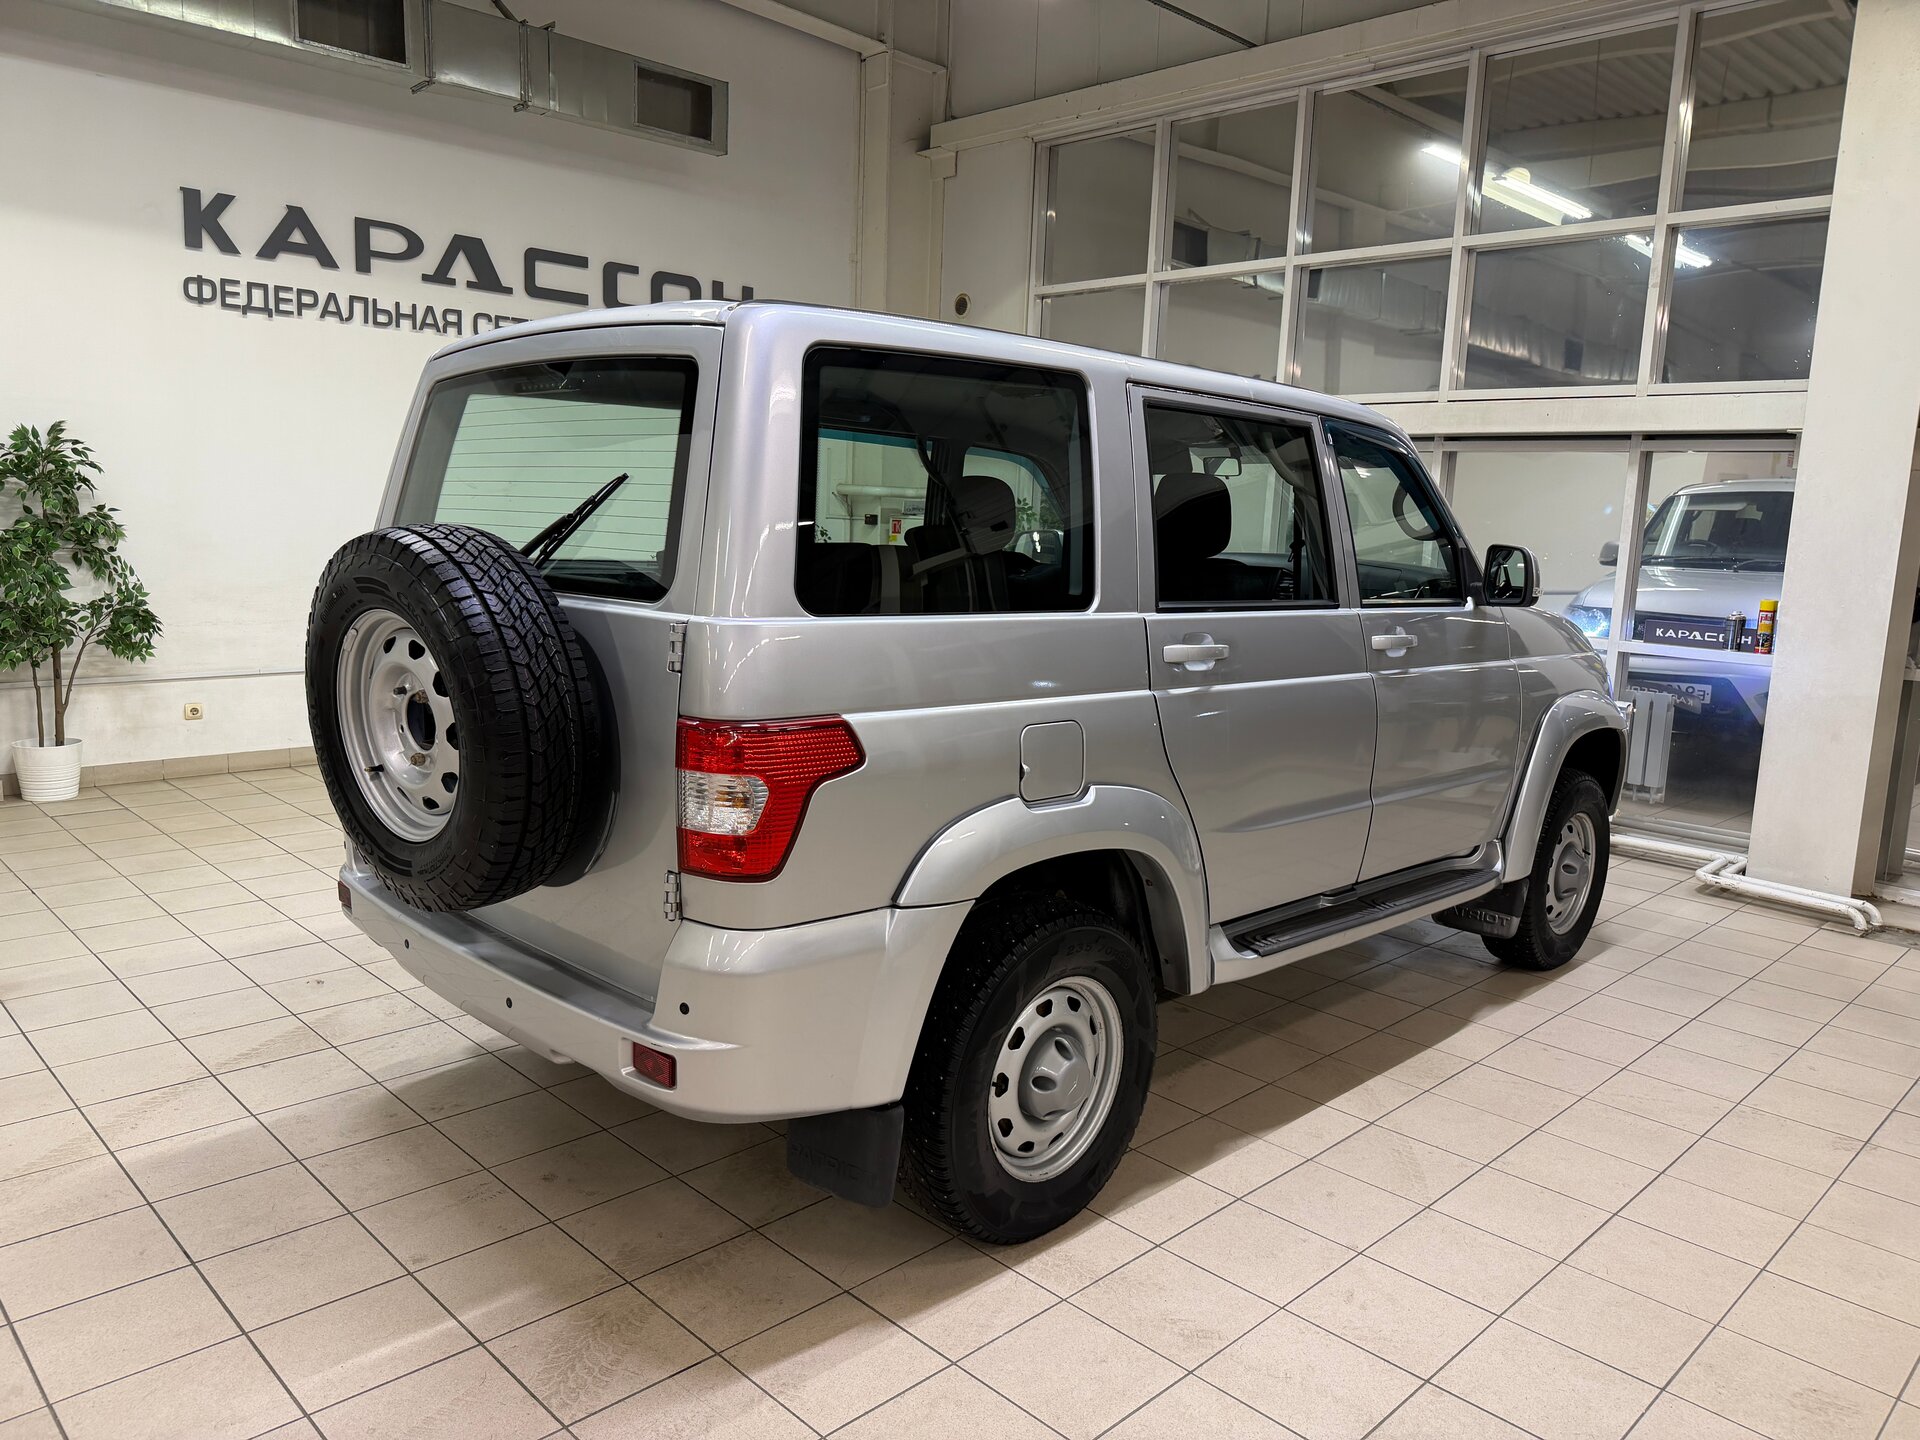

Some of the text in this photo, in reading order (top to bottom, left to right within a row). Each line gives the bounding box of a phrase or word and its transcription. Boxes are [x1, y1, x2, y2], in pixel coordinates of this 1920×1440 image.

[182, 274, 534, 336] ФЕДЕРАЛЬНАЯ СЕ
[1655, 627, 1752, 645] КАРЛССН
